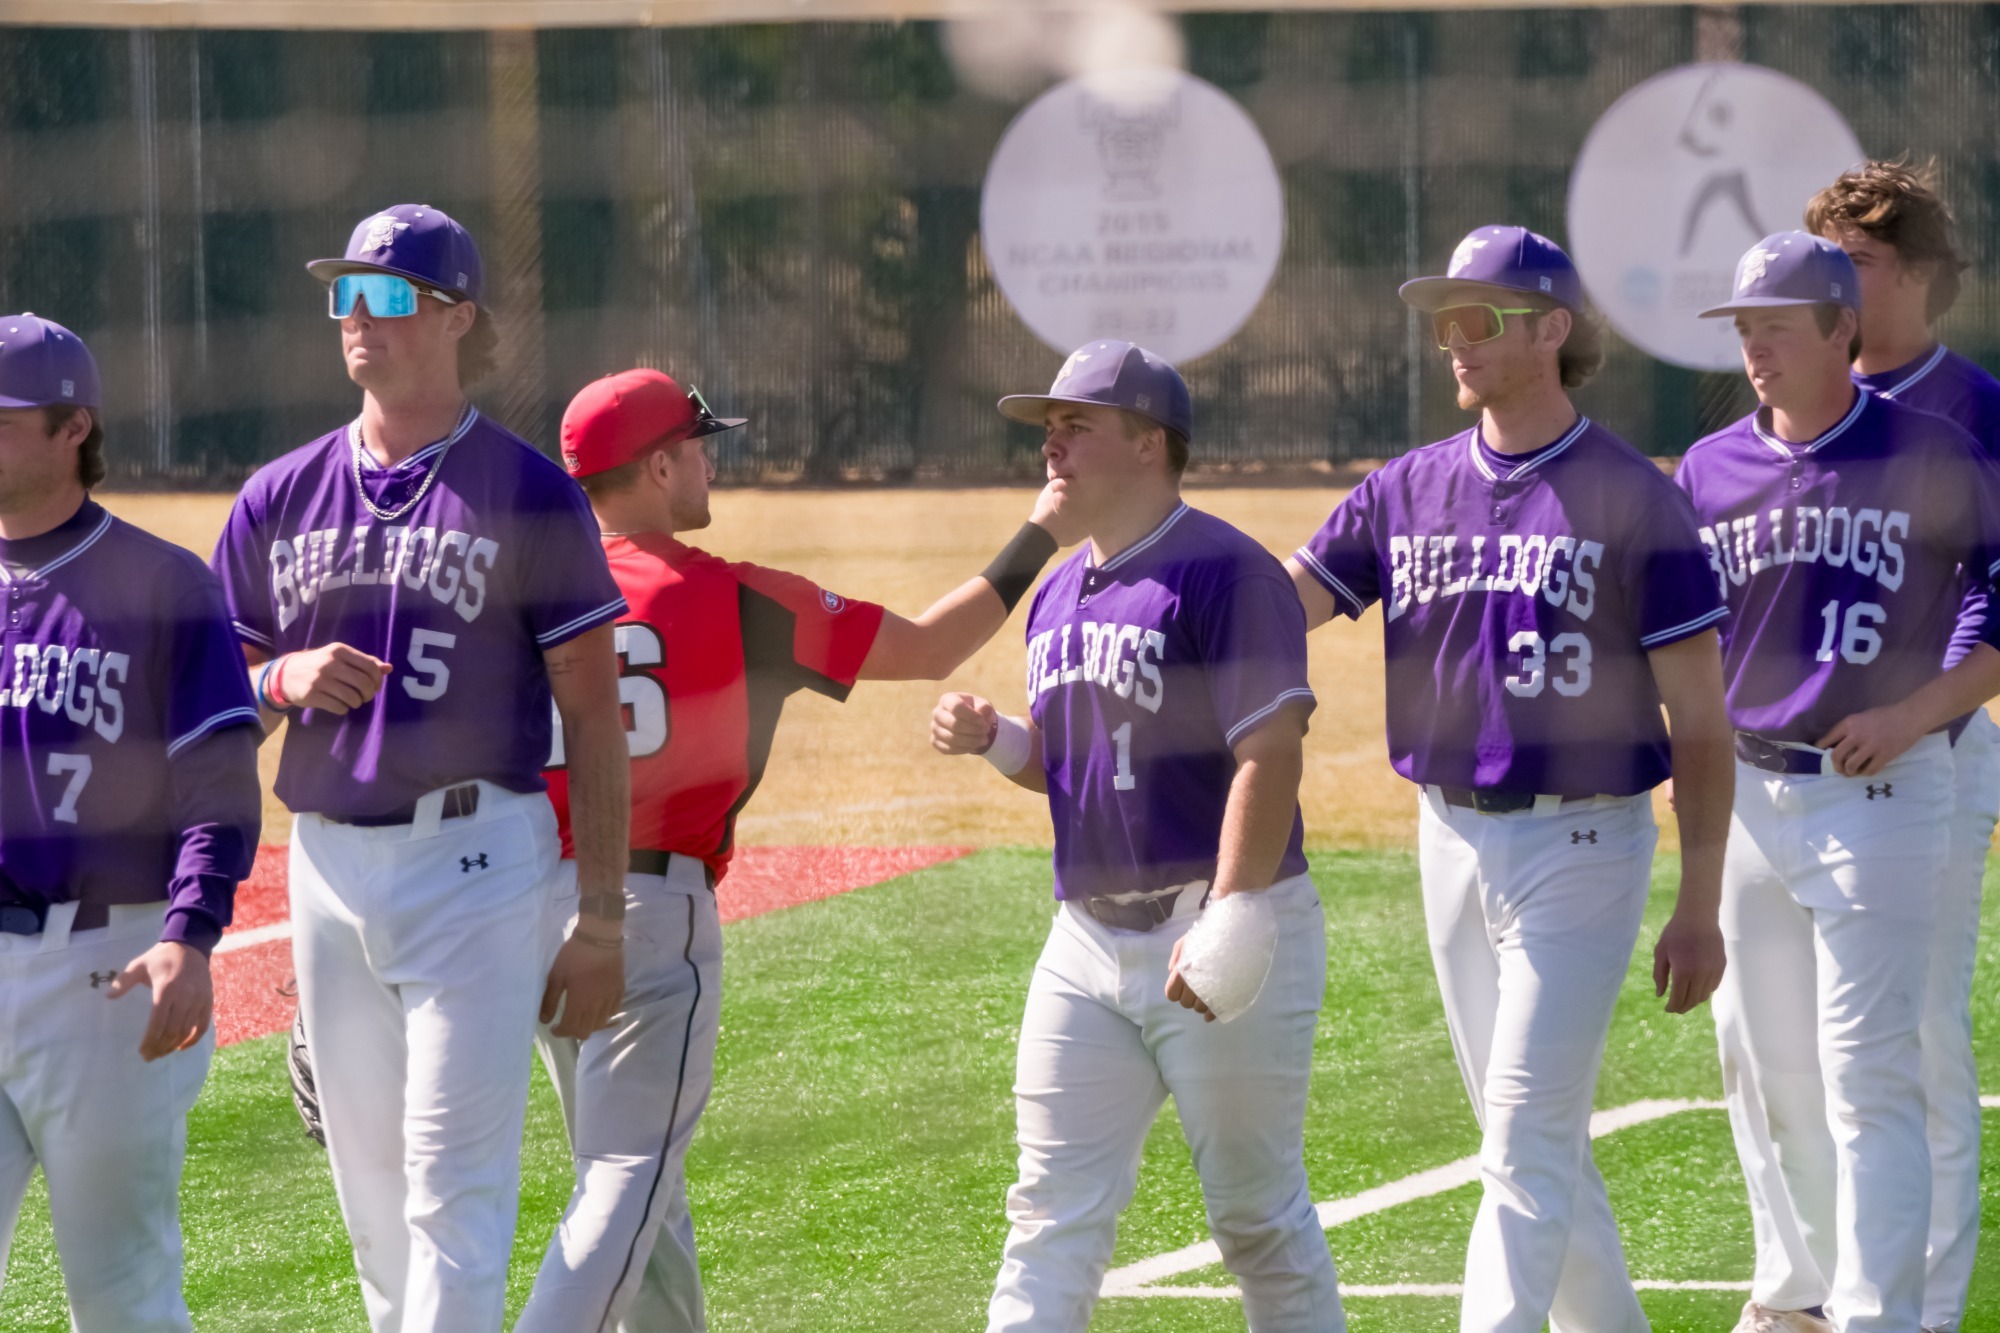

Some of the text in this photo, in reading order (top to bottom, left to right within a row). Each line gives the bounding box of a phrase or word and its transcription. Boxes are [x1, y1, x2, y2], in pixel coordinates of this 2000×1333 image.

[1008, 238, 1256, 266] NCAA REGIONAL
[1038, 270, 1230, 295] CHAMPIONS
[269, 525, 500, 633] BULLDOGS
[1388, 534, 1605, 624] BULLDOGS
[1699, 506, 1910, 600] BULLDOGS
[401, 627, 457, 701] 5
[1027, 621, 1166, 714] ULLDOGS
[1505, 630, 1593, 698] 33
[1815, 599, 1888, 666] 16
[0, 643, 131, 744] DOGS
[46, 752, 93, 824] 7
[1112, 721, 1136, 791] 1
